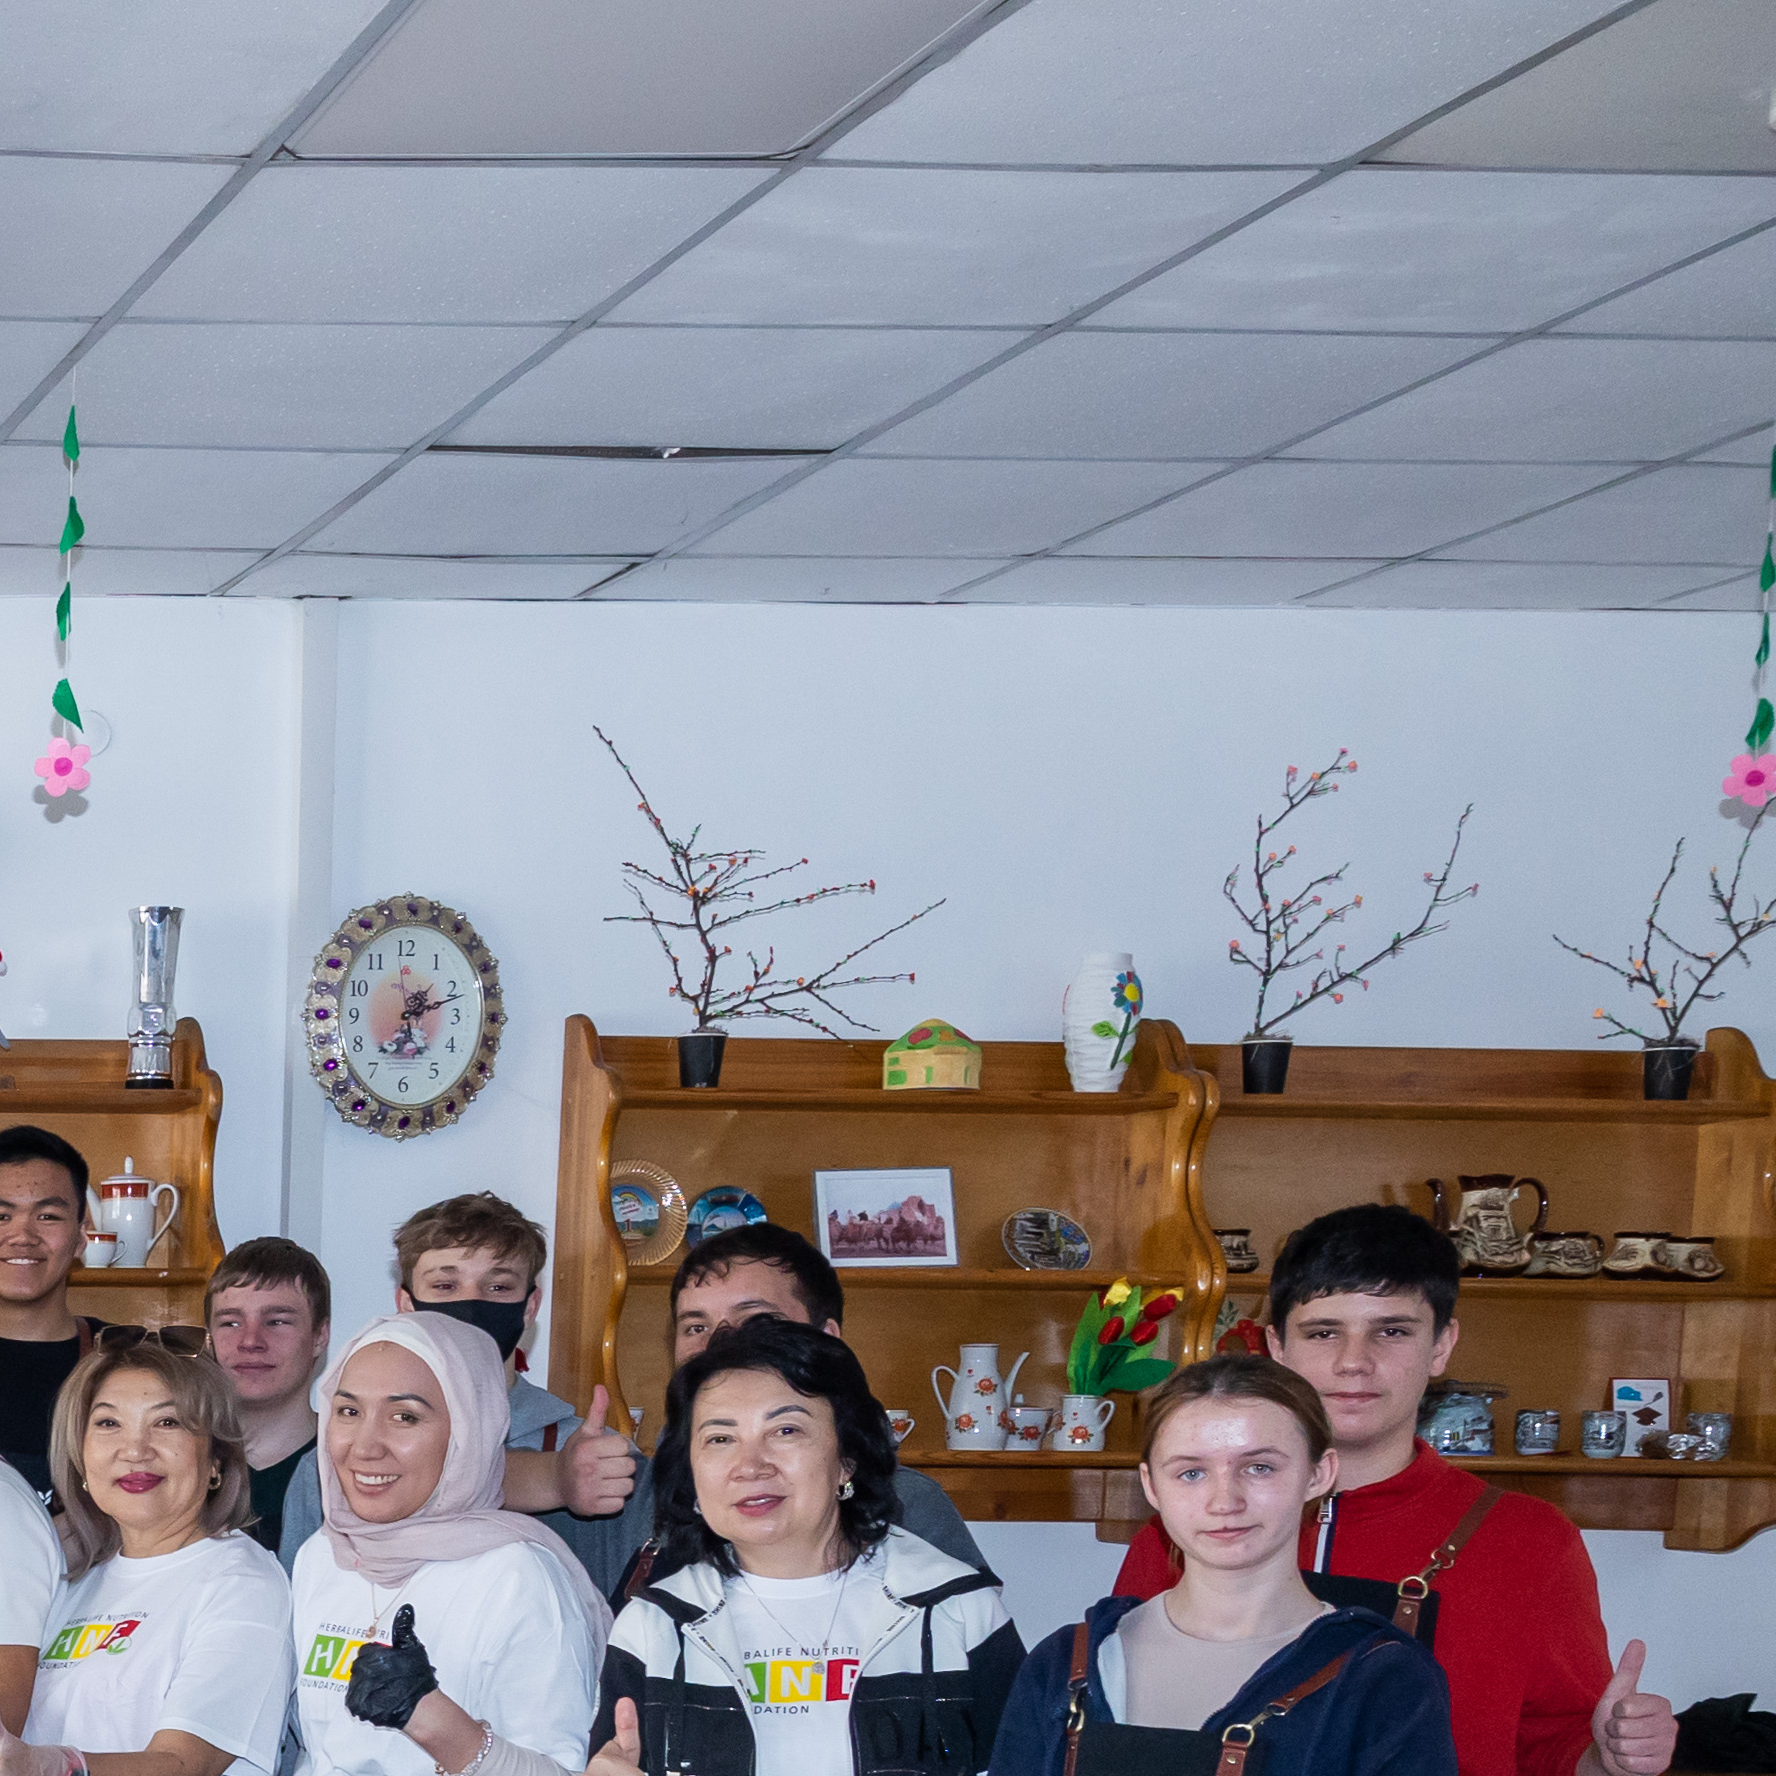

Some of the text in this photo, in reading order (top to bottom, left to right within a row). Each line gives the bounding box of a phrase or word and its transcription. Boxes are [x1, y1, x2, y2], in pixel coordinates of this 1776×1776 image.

[397, 939, 416, 957] 12
[367, 953, 384, 970] 11
[433, 953, 439, 970] 1
[350, 979, 368, 997] 10
[446, 980, 457, 997] 2
[348, 1007, 360, 1025] 9
[450, 1008, 461, 1025] 3
[352, 1035, 363, 1053] 8
[445, 1035, 457, 1053] 4
[367, 1062, 379, 1080] 7
[428, 1062, 439, 1080] 5
[397, 1075, 409, 1093] 6
[319, 1622, 366, 1638] HERBALIFE
[743, 1646, 859, 1661] BALIFE NUTRITI
[753, 1705, 810, 1715] DATION
